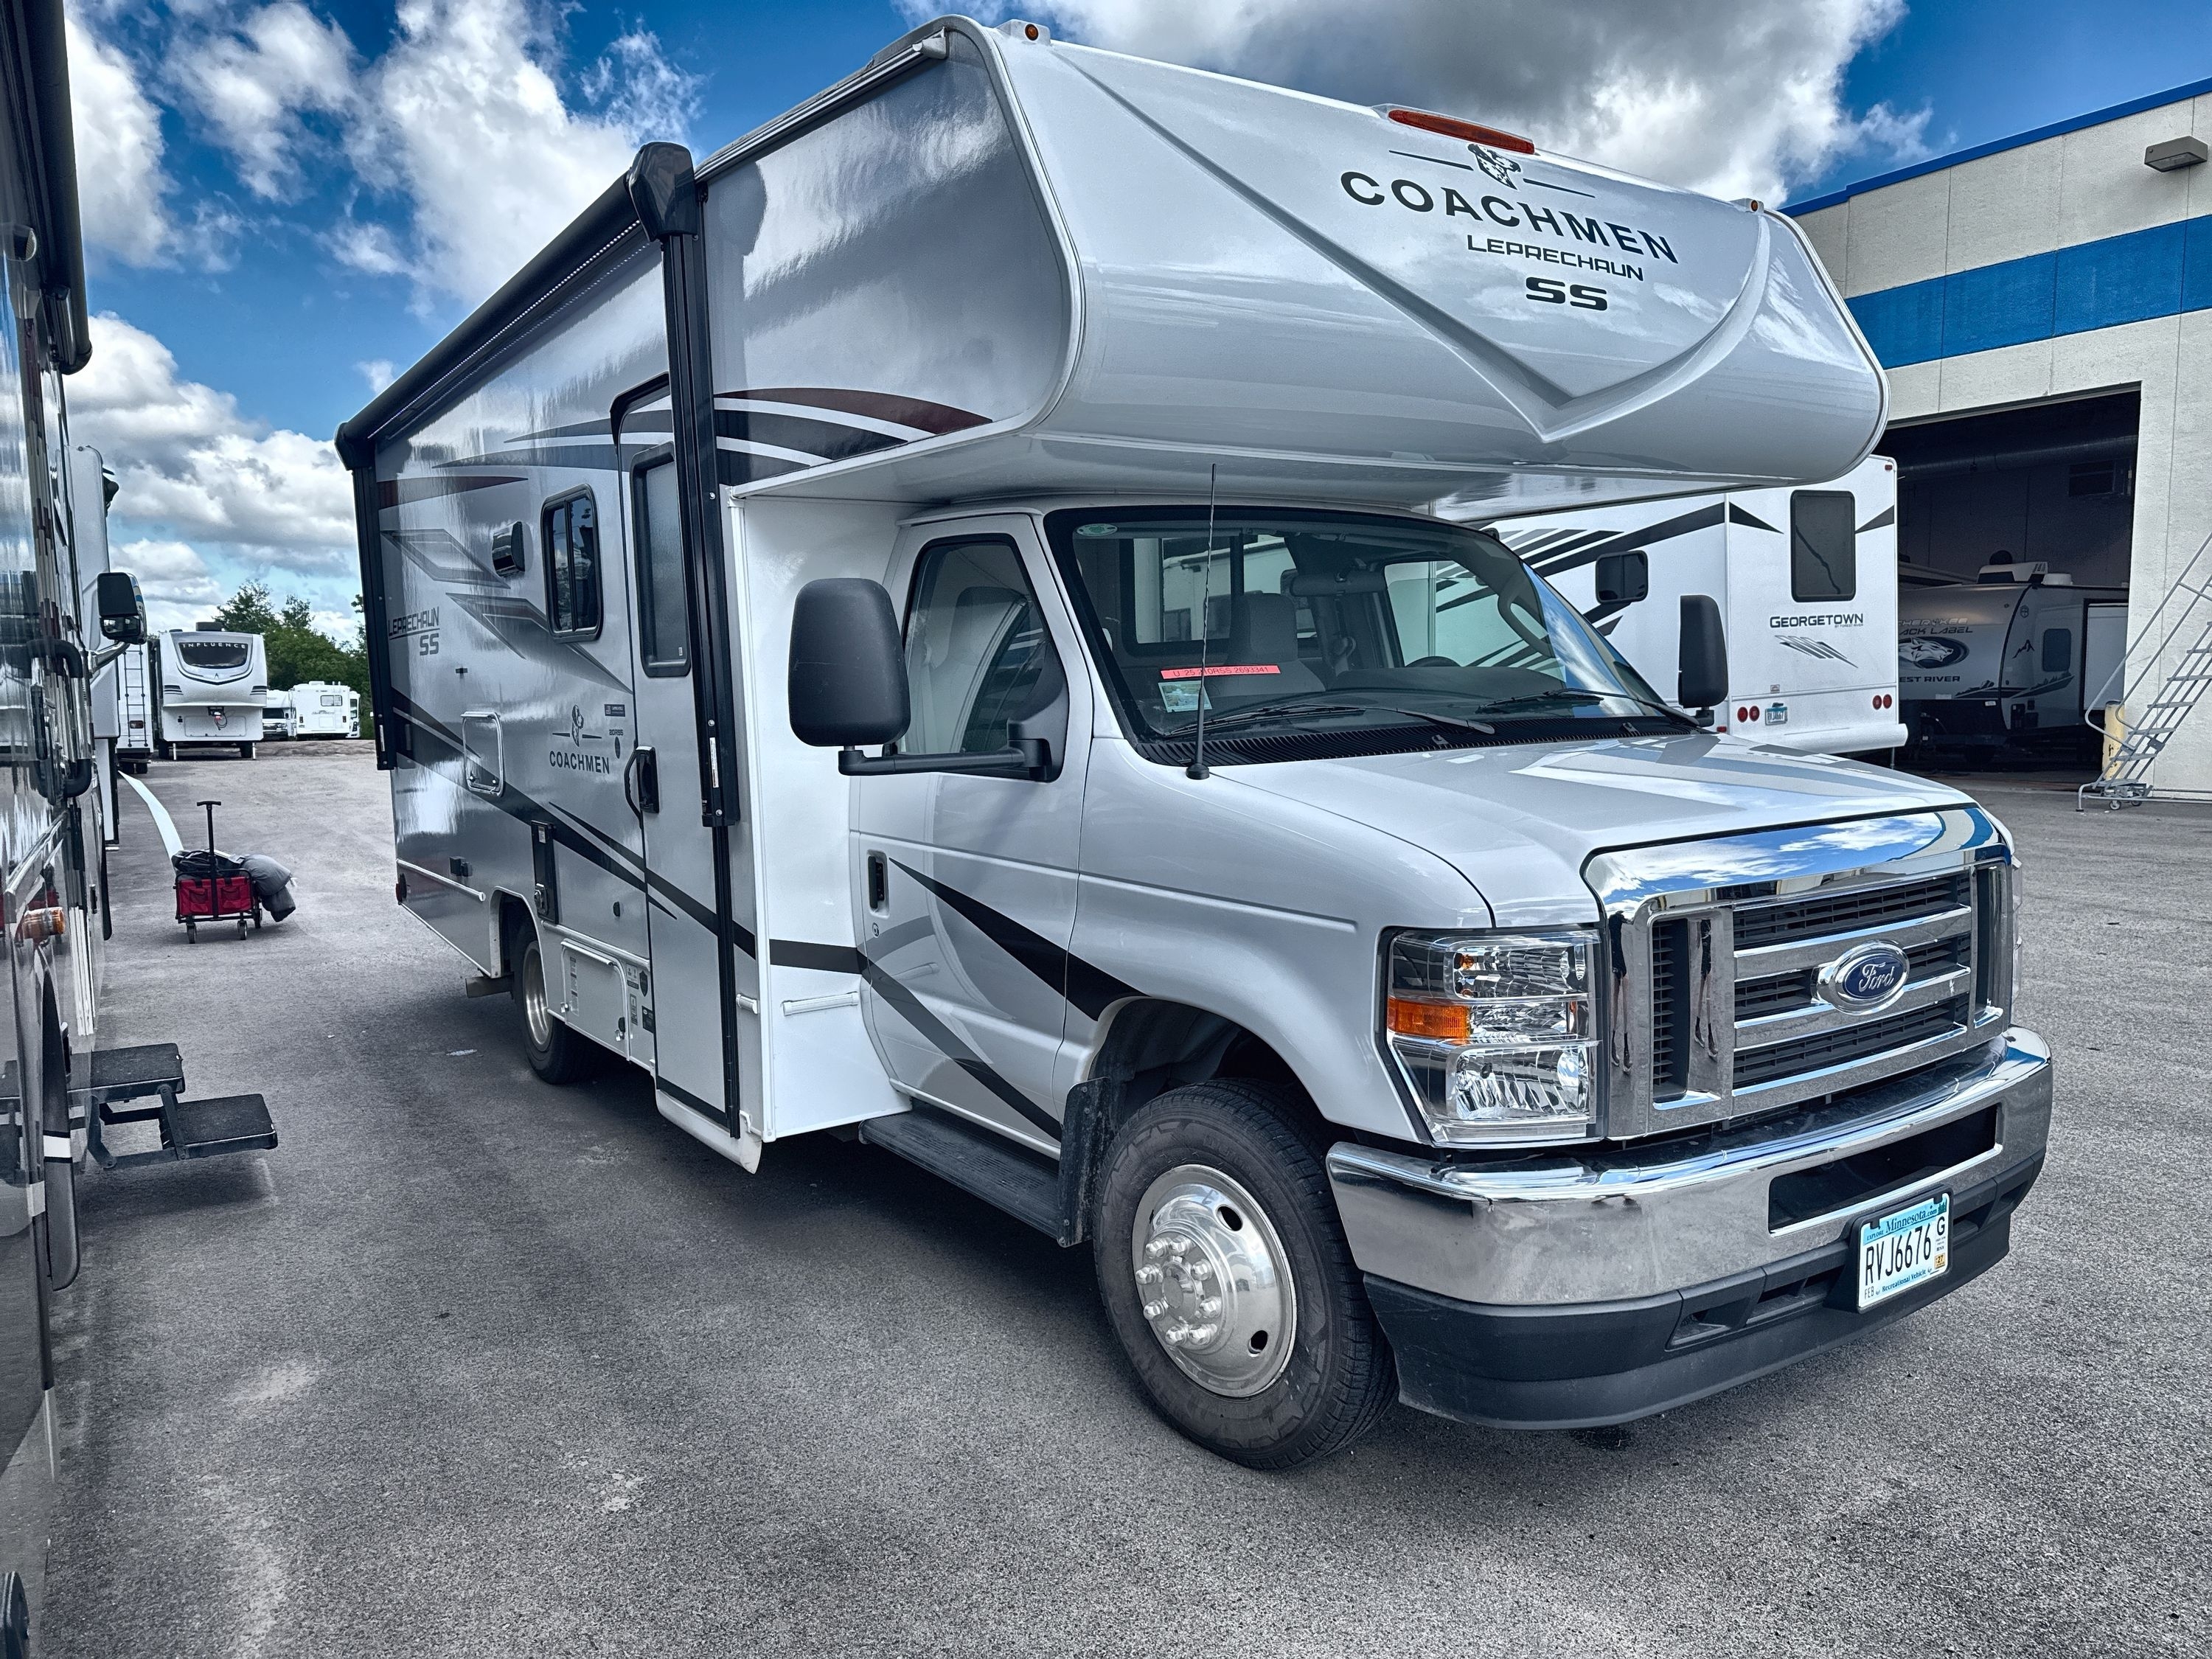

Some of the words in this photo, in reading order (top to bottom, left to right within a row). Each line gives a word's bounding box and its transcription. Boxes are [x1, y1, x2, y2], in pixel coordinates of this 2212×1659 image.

[1340, 171, 1679, 264] COACHMEN
[1467, 234, 1644, 282] LEPRECHAUN
[1526, 276, 1607, 311] SS
[389, 606, 439, 636] LEPRECHAUN
[1770, 613, 1863, 628] GEORGETOWN
[1930, 626, 1973, 634] LABEL
[420, 633, 439, 655] SS
[549, 751, 610, 774] COACHMEN
[1858, 962, 1895, 992] Ford
[1936, 1216, 1945, 1236] G
[1865, 1222, 1931, 1286] RVJ6676
[1864, 1286, 1874, 1300] FEB
[1882, 1276, 1910, 1293] Recreational
[1911, 1269, 1926, 1280] Vehicle
